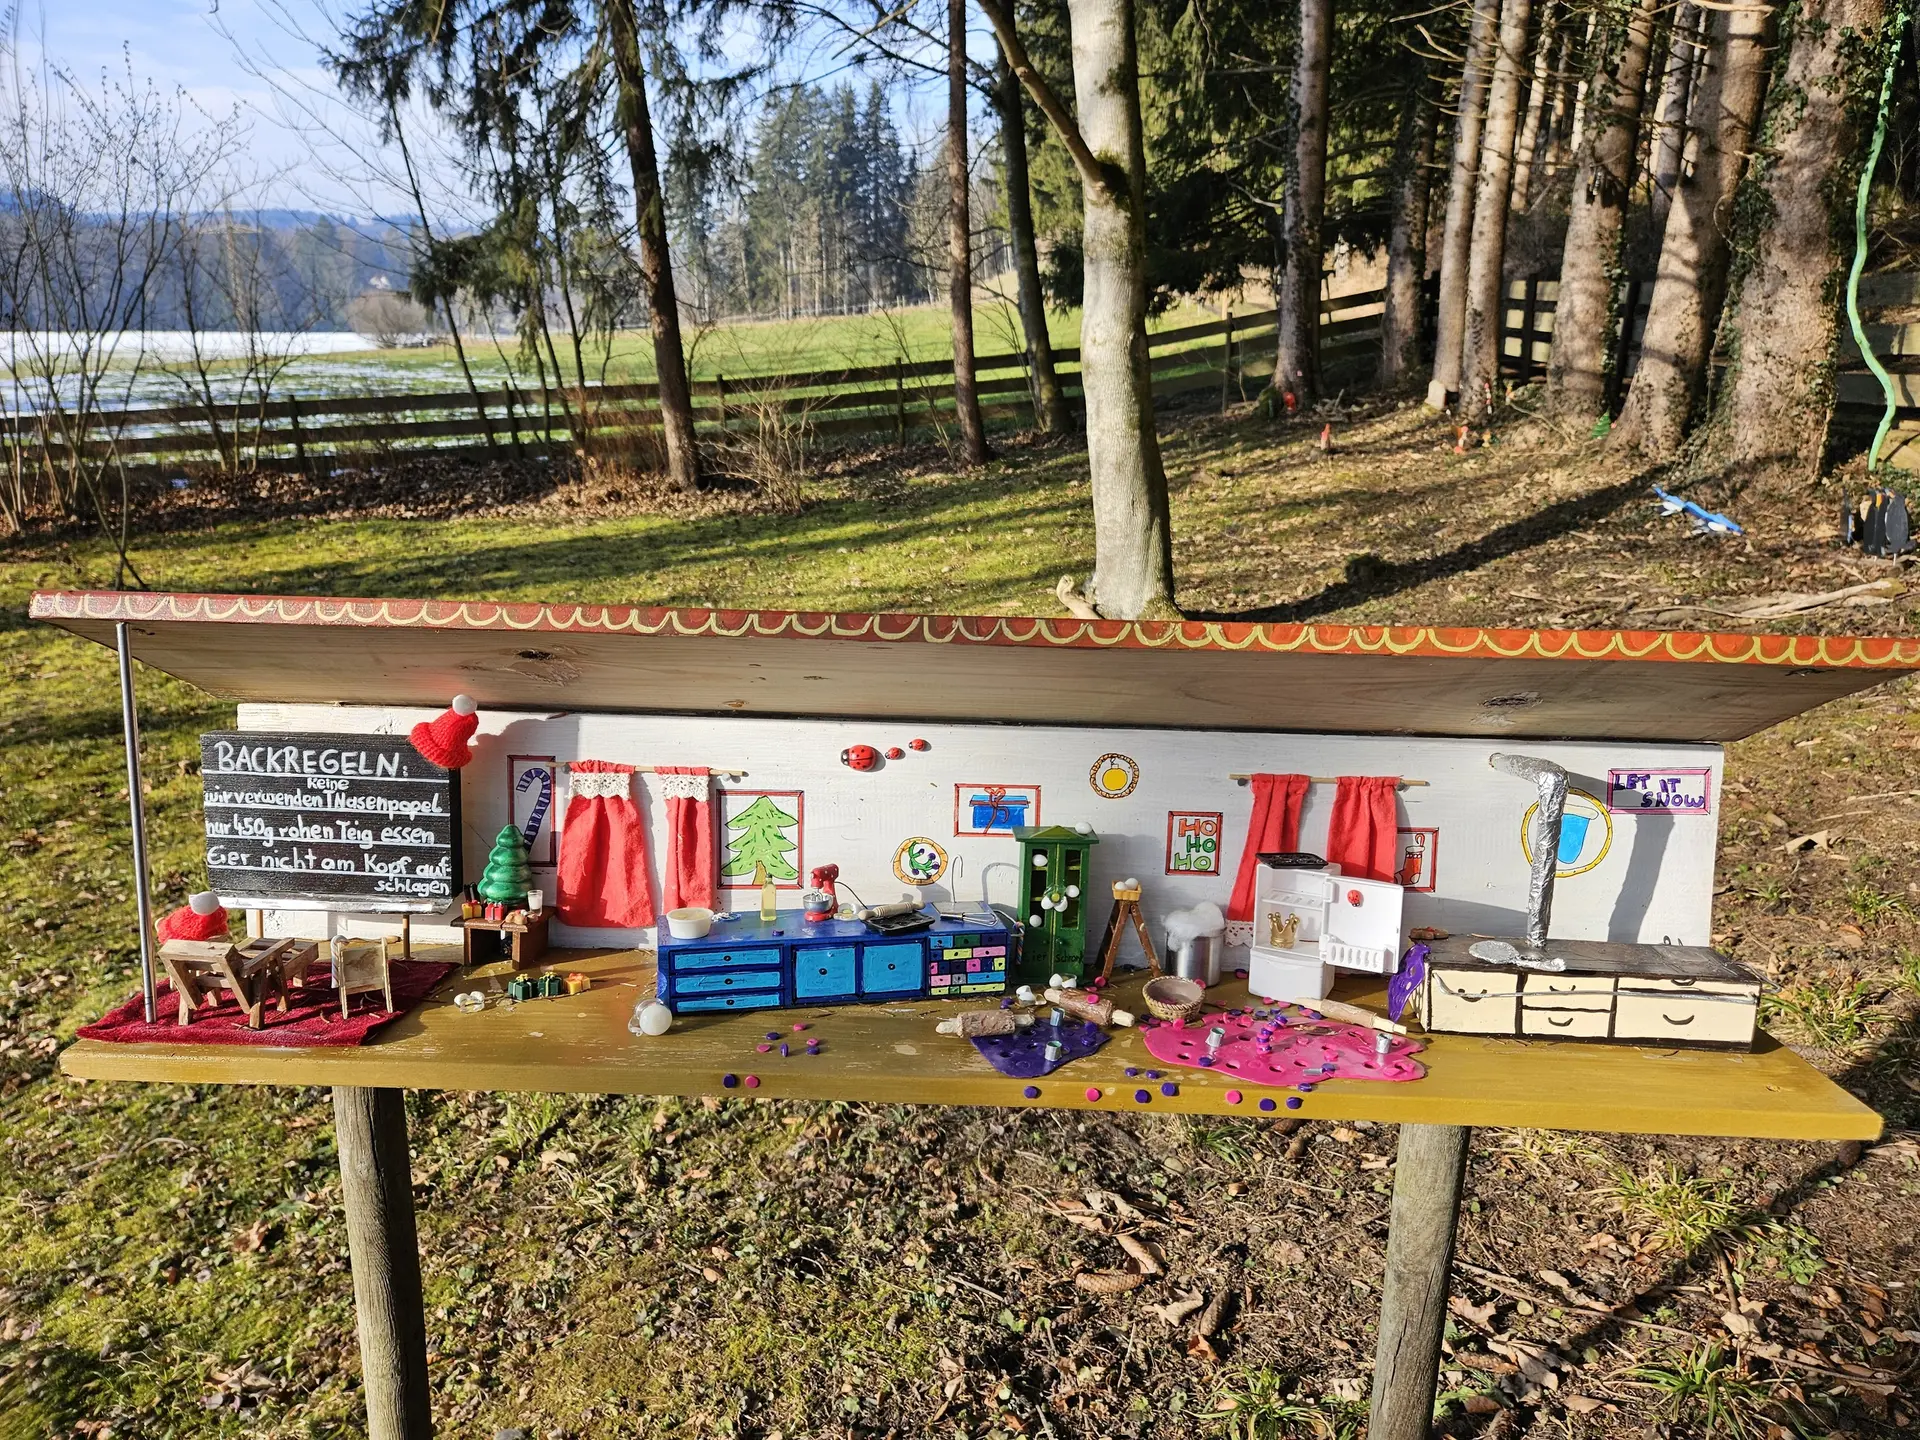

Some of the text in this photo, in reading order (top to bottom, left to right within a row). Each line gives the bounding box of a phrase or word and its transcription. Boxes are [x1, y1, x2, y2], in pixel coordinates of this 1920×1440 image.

[214, 740, 409, 778] BACKREGELN:
[1613, 773, 1681, 793] LET IT
[204, 785, 443, 821] wir verwenden Nasenpopel
[1641, 791, 1705, 808] SNOW
[206, 813, 435, 850] nur 450g rohen Teig essen
[1178, 818, 1217, 837] HO
[1186, 834, 1217, 853] HO
[261, 846, 317, 871] nicht
[321, 858, 355, 872] am
[363, 852, 412, 882] Kopf
[1174, 852, 1212, 871] HO
[373, 878, 450, 897] schlagen
